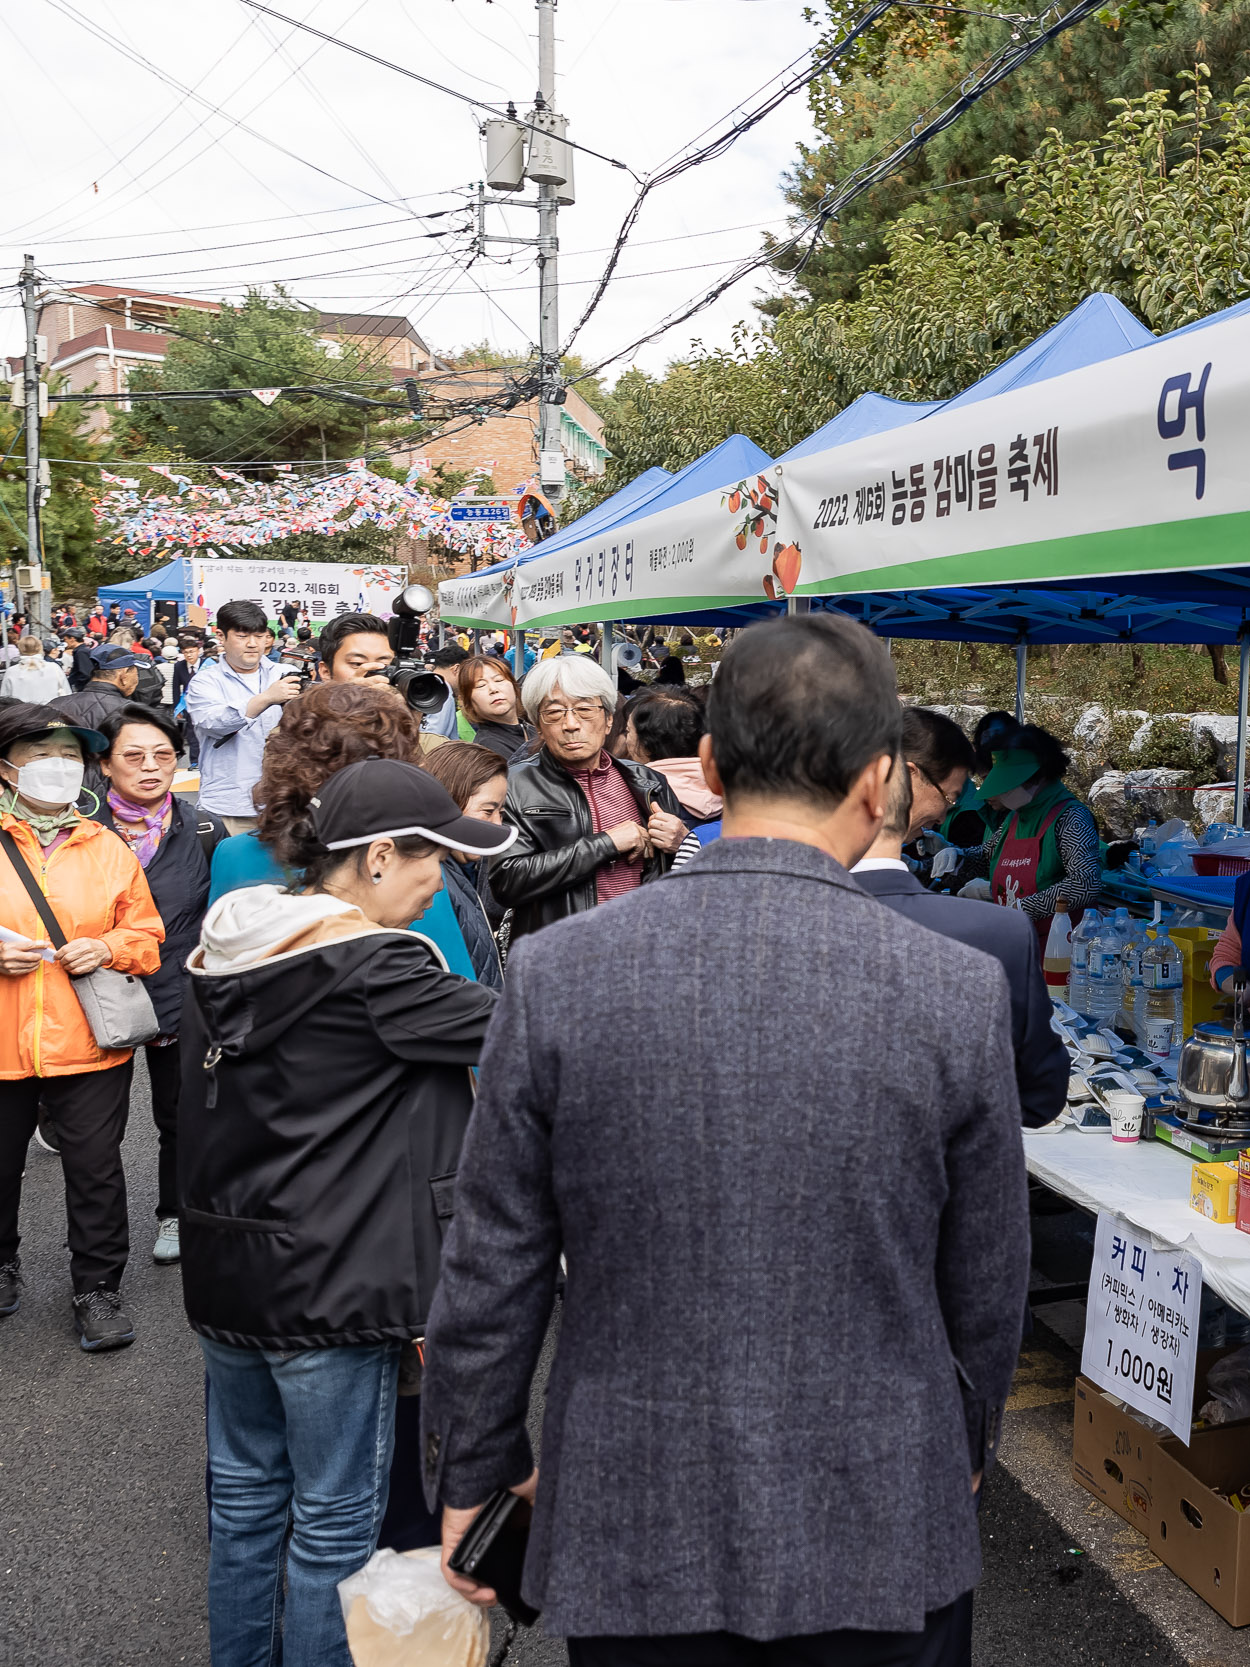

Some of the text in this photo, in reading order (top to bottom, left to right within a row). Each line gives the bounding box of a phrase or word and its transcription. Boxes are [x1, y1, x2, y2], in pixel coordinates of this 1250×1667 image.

[812, 425, 1060, 530] 2023. 제6회 능동 감마을 축제
[259, 581, 340, 595] 2023. 제6회
[272, 599, 328, 617] 감을
[1111, 1235, 1147, 1282] 커피
[1171, 1266, 1189, 1304] 차
[1101, 1272, 1136, 1307] (커피믹스
[1147, 1297, 1189, 1339] 아메리카노
[1113, 1303, 1139, 1334] 쌍화차
[1150, 1325, 1181, 1358] 생강차)
[1105, 1338, 1173, 1406] 1,000원
